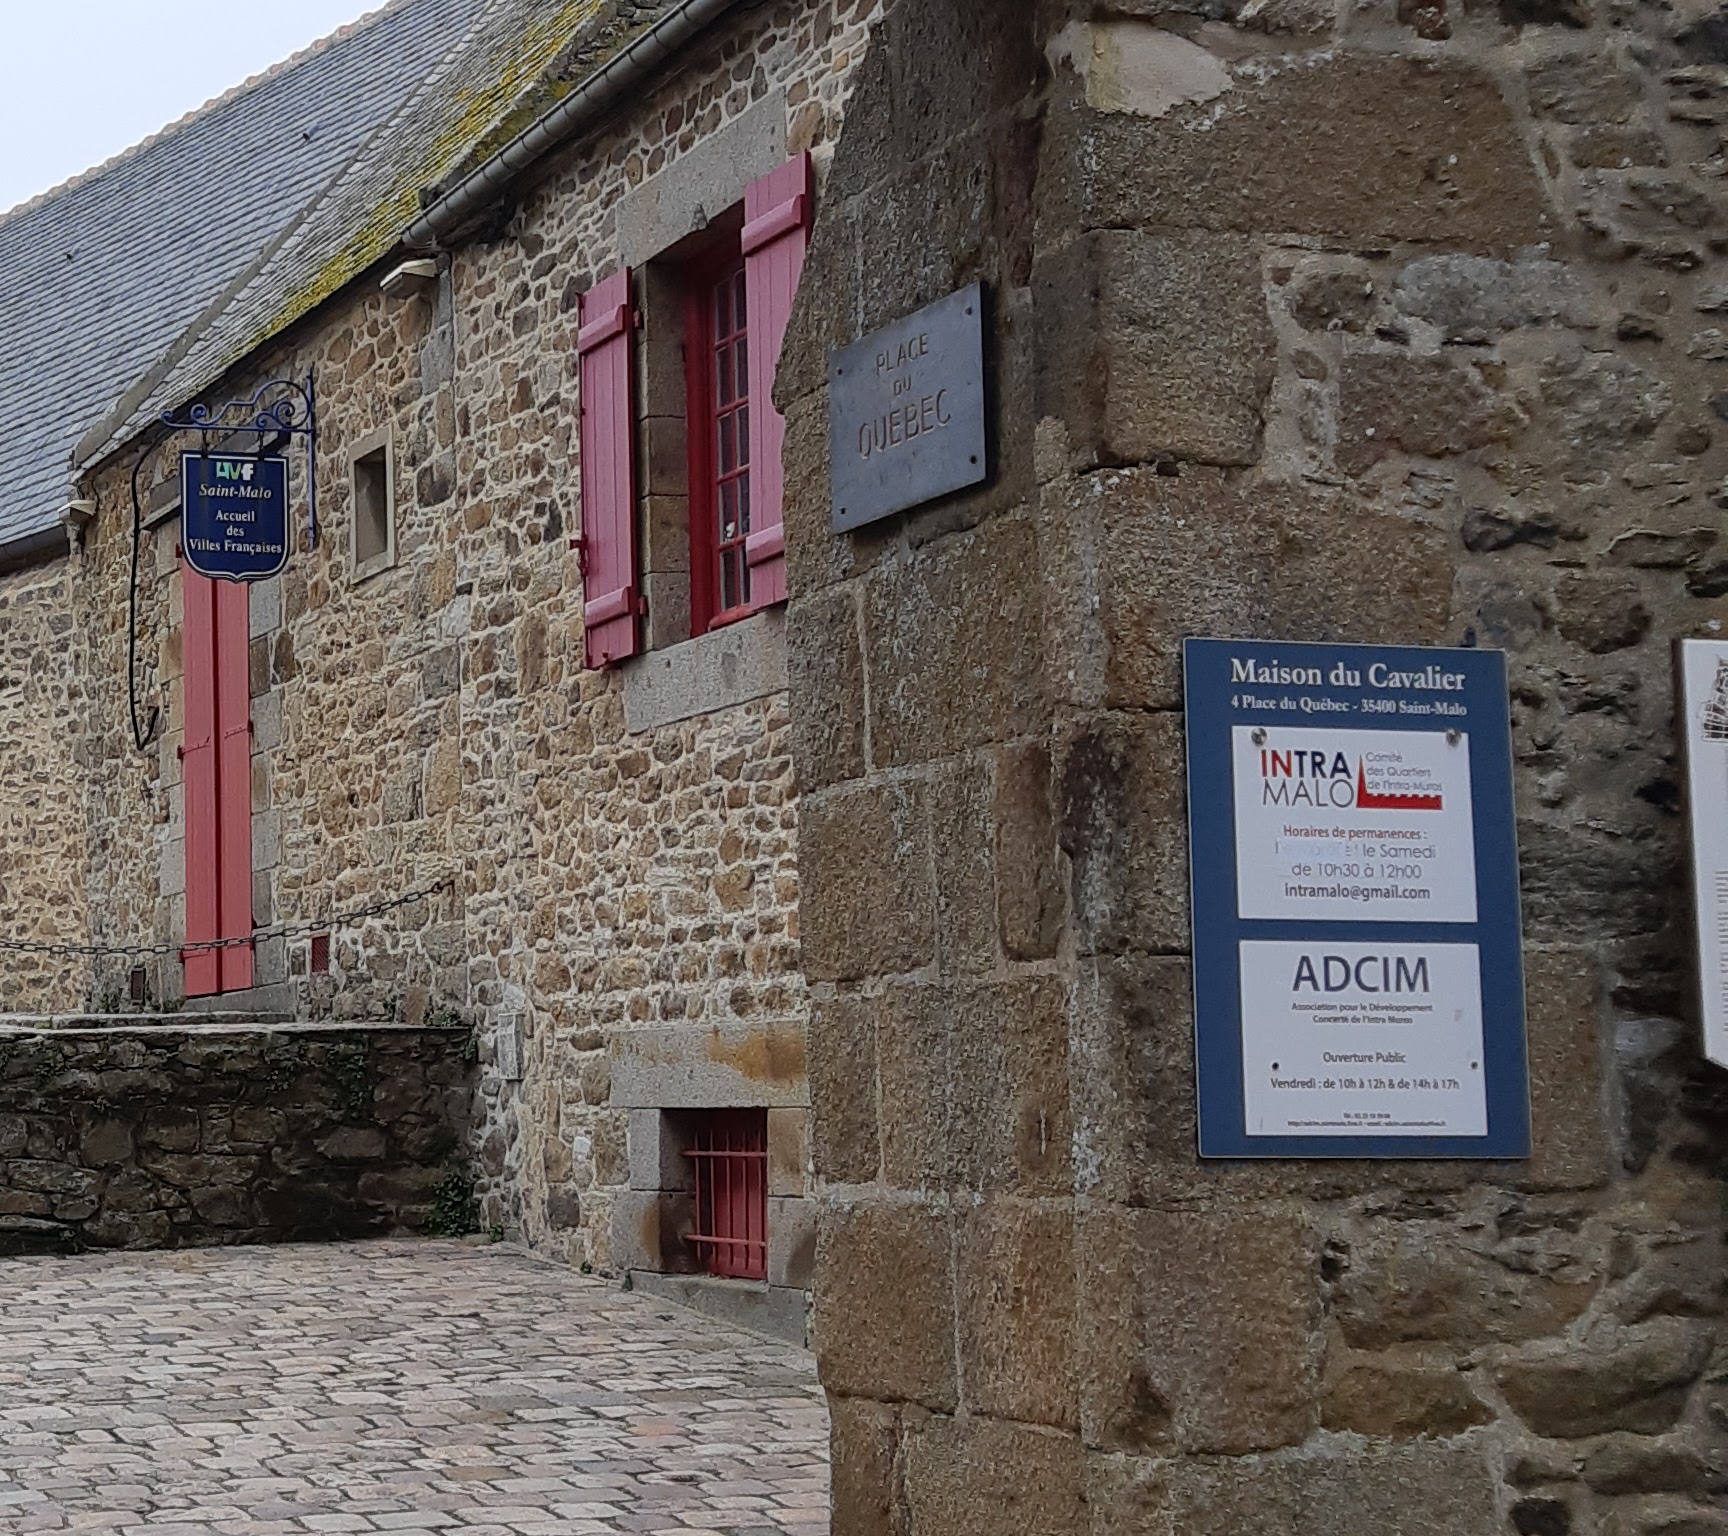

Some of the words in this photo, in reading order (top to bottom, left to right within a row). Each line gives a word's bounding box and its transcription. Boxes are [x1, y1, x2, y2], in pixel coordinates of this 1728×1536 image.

[876, 333, 928, 376] PLACE
[893, 375, 912, 396] DU
[859, 388, 952, 458] QUEBEC
[199, 483, 272, 499] Saint-Malo
[215, 509, 255, 522] Accueil
[226, 525, 245, 537] des
[189, 538, 221, 551] Villes
[224, 540, 282, 556] Françaises
[1231, 657, 1323, 685] Maison
[1329, 661, 1361, 687] du
[1368, 662, 1466, 691] Cavalier
[1231, 694, 1239, 709] 4
[1242, 694, 1276, 710] Place
[1280, 696, 1297, 710] du
[1299, 696, 1350, 714] Québec
[1360, 698, 1396, 714] 35400
[1399, 700, 1468, 717] Saint-Malo
[1261, 749, 1353, 779] INTRA
[1262, 778, 1355, 808] MALO
[1283, 825, 1329, 838] Horaires
[1332, 826, 1345, 838] de
[1348, 828, 1421, 841] permanences
[1363, 844, 1375, 857] le
[1379, 843, 1436, 859] Samedi
[1292, 863, 1312, 876] de
[1318, 863, 1360, 878] 10h30
[1364, 863, 1374, 877] à
[1380, 864, 1422, 879] 12h00
[1285, 882, 1431, 902] intramalo@gmail.com
[1292, 955, 1431, 993] ADCIM
[1292, 1002, 1337, 1011] Association
[1339, 1003, 1358, 1012] pour
[1360, 1003, 1367, 1011] le
[1323, 1051, 1373, 1063] Ouverture
[1376, 1051, 1407, 1063] Public
[1271, 1078, 1316, 1089] Vendredi
[1323, 1078, 1336, 1089] de
[1339, 1079, 1356, 1089] 10h
[1369, 1079, 1385, 1089] 12h
[1389, 1079, 1395, 1089] &
[1397, 1078, 1410, 1089] de
[1413, 1079, 1431, 1089] 14h
[1442, 1079, 1459, 1090] 17h
